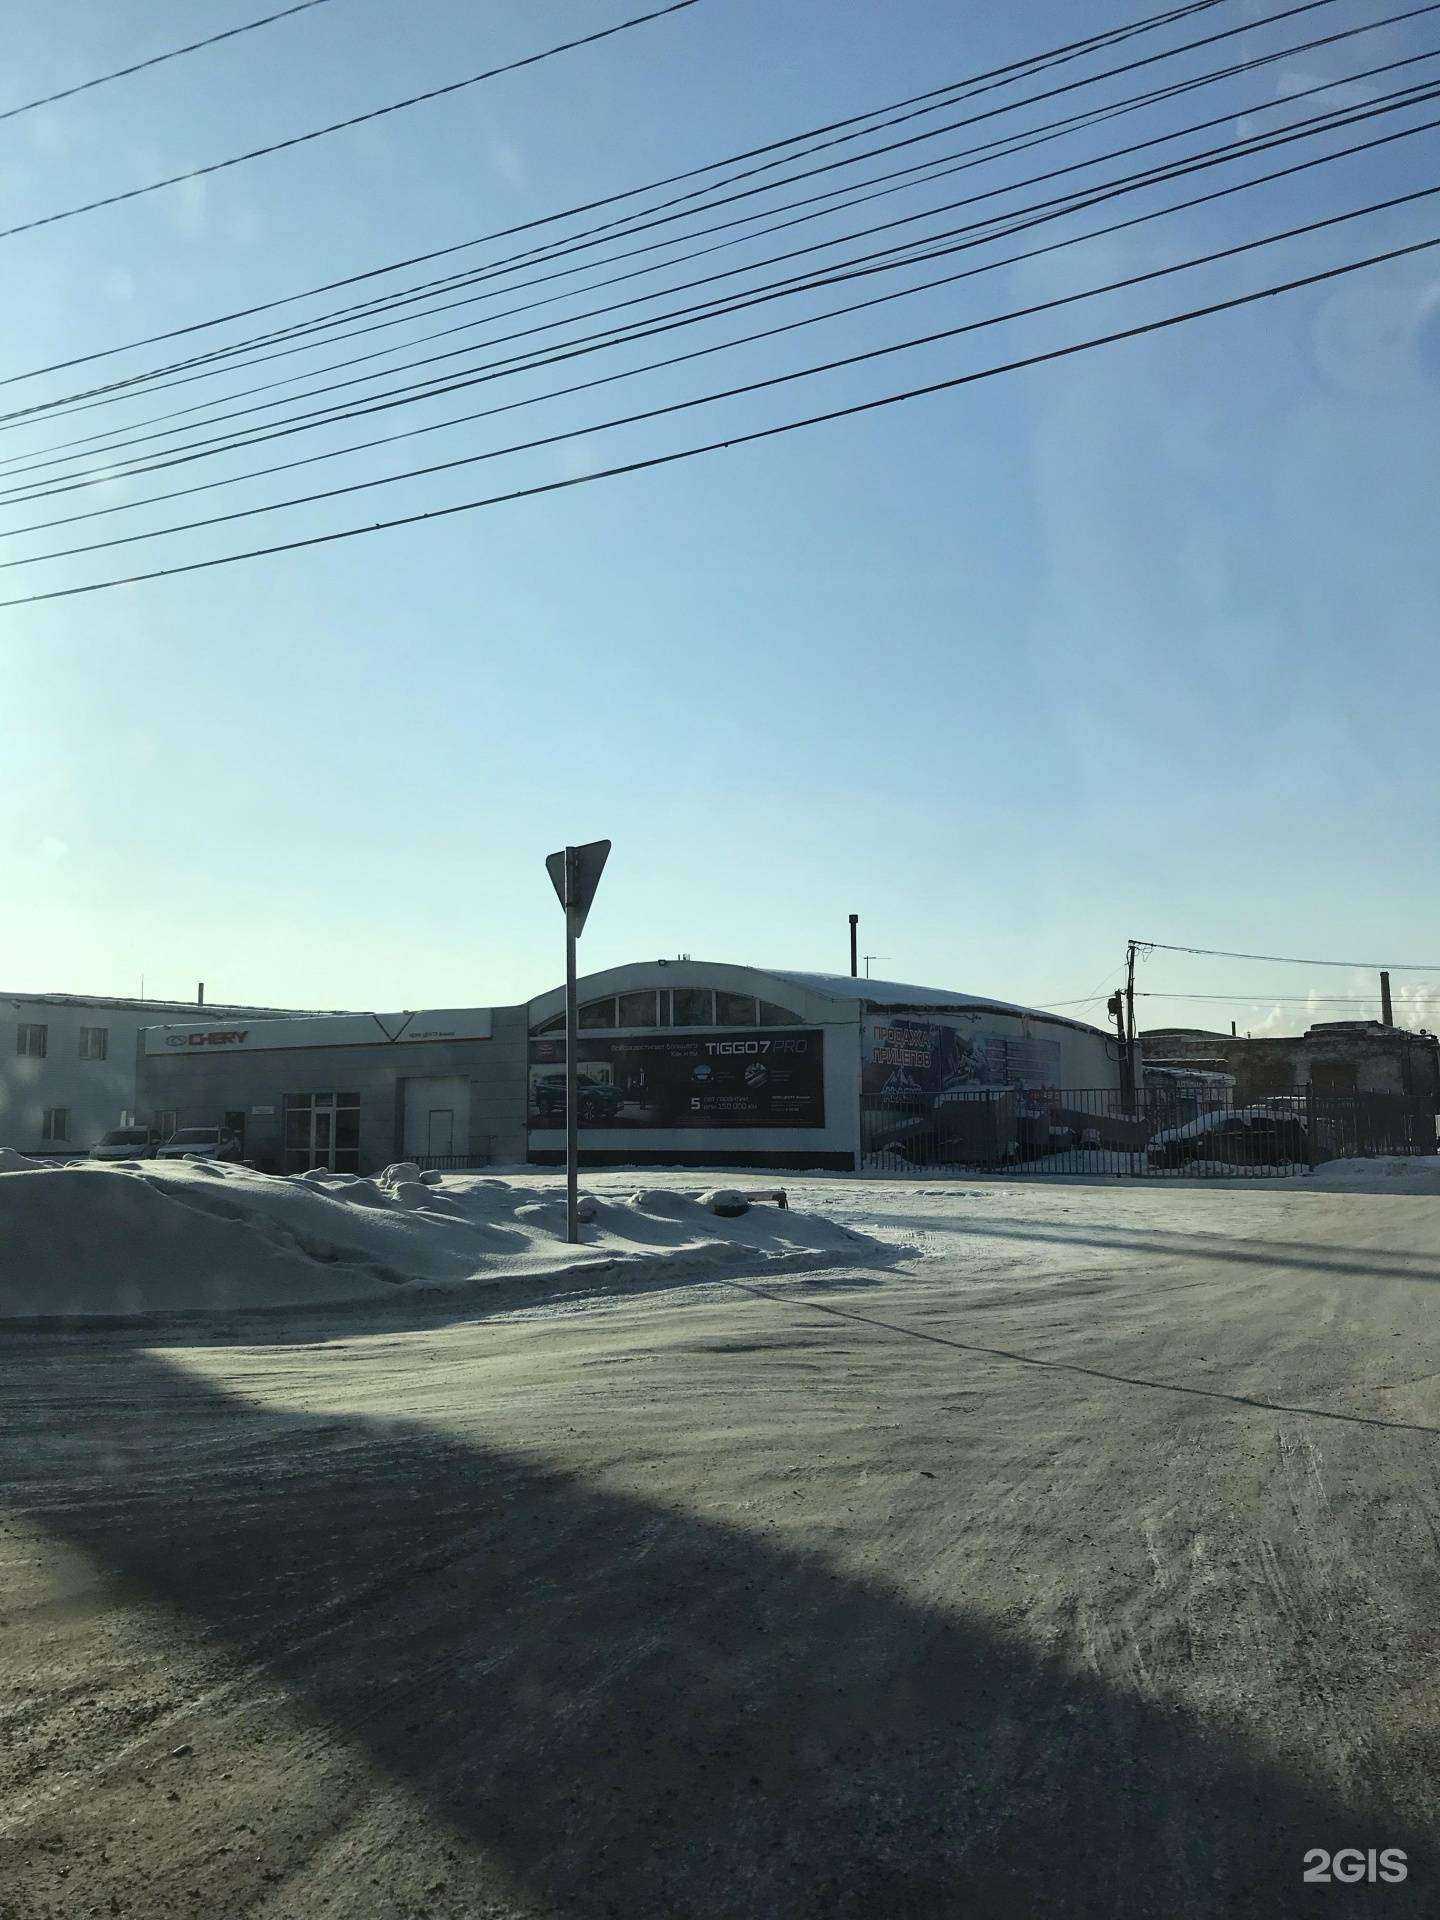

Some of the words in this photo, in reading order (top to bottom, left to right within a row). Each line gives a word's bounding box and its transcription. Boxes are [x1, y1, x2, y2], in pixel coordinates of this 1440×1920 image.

[188, 1031, 249, 1046] CHERY
[873, 1025, 929, 1046] ПРОДАЖА
[773, 1039, 808, 1054] PRO
[873, 1047, 931, 1067] ПРИЦЕПОВ
[690, 1097, 701, 1110] 5
